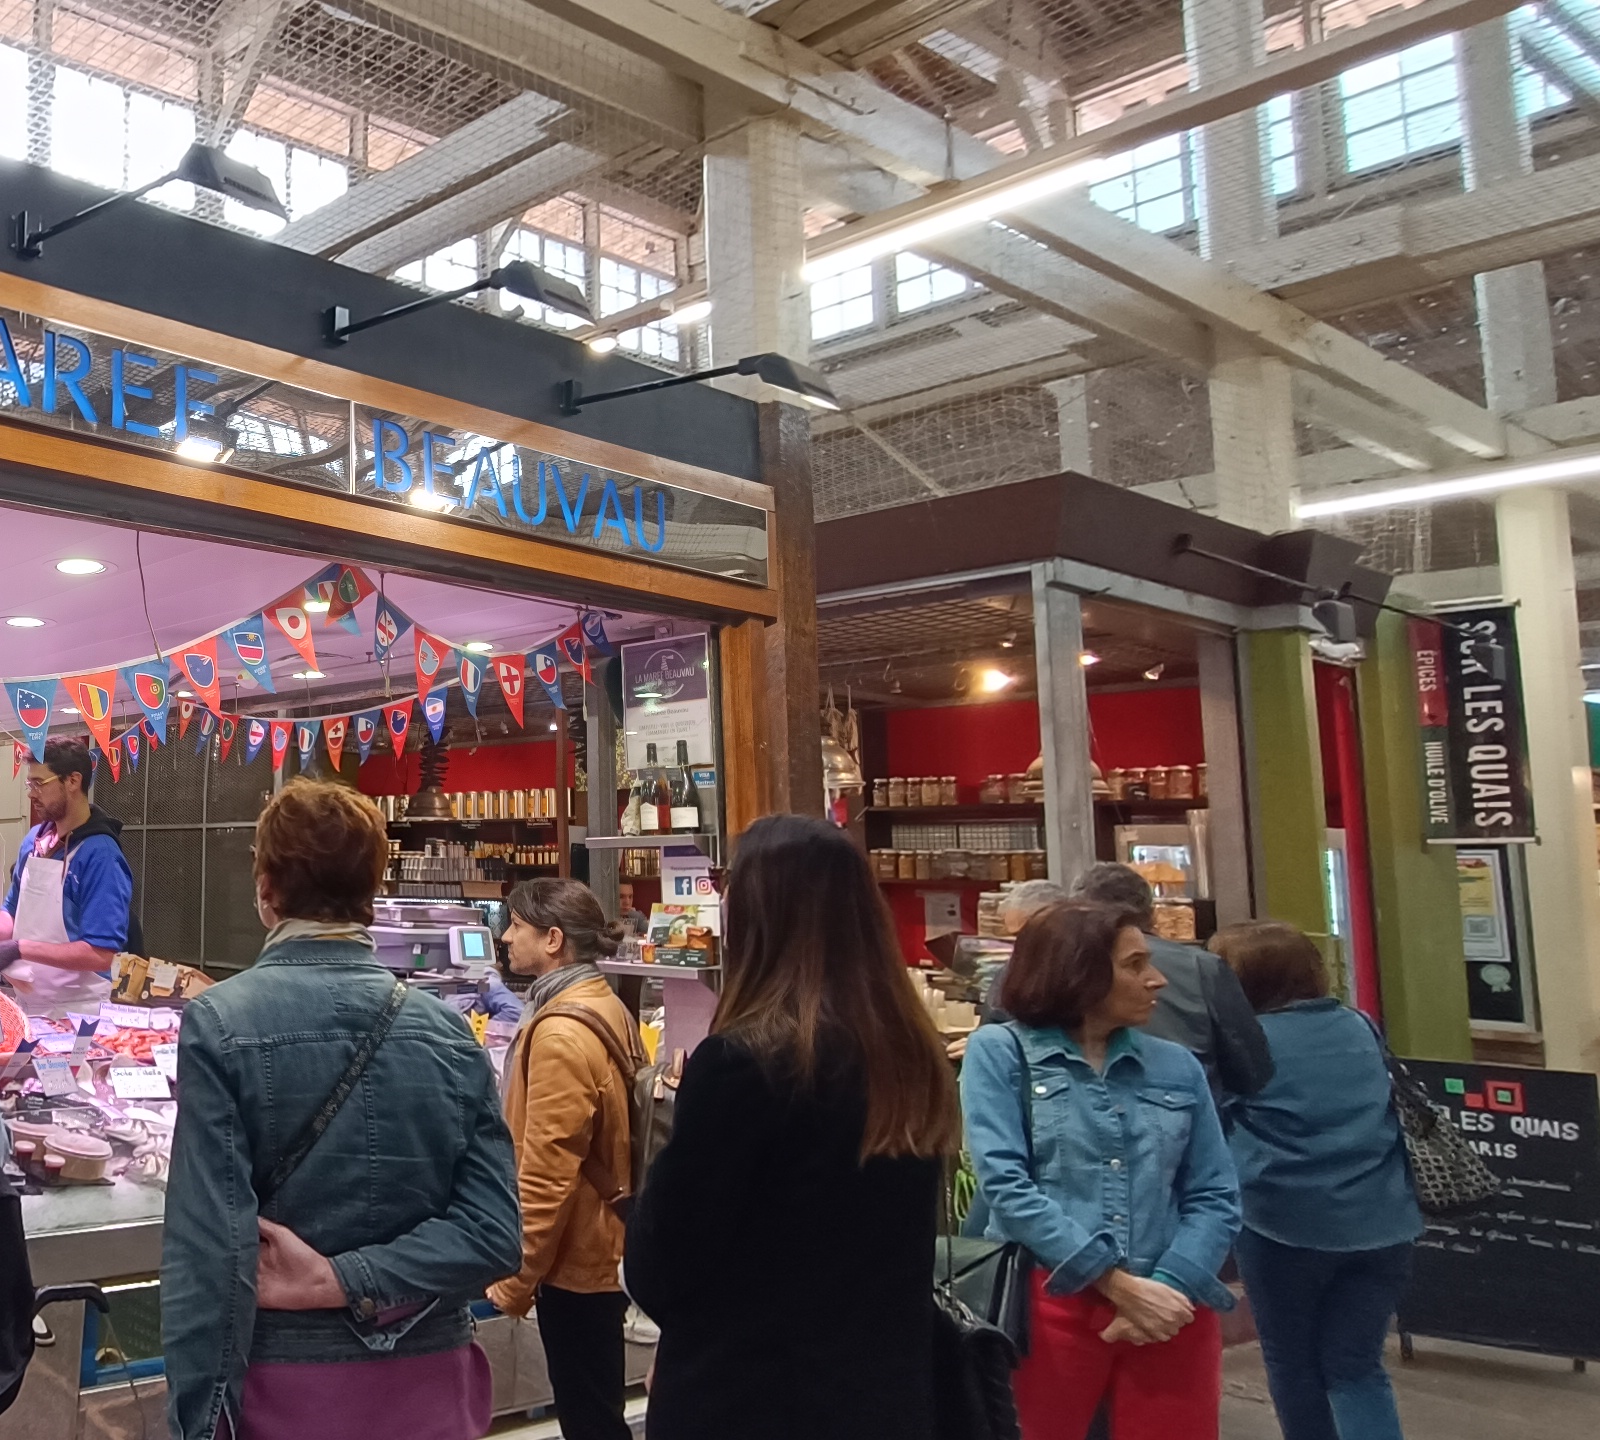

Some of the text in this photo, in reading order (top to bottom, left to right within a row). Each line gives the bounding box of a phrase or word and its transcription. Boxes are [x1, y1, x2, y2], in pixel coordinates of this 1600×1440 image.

[372, 417, 667, 553] BEAUVAU
[1416, 649, 1438, 692] ÉPICES
[1461, 684, 1505, 734] LES
[1428, 778, 1449, 825] D'OLIVE
[1466, 744, 1513, 829] QUAIS
[1468, 1140, 1519, 1160] ARIS
[1509, 1115, 1581, 1142] QUAIS
